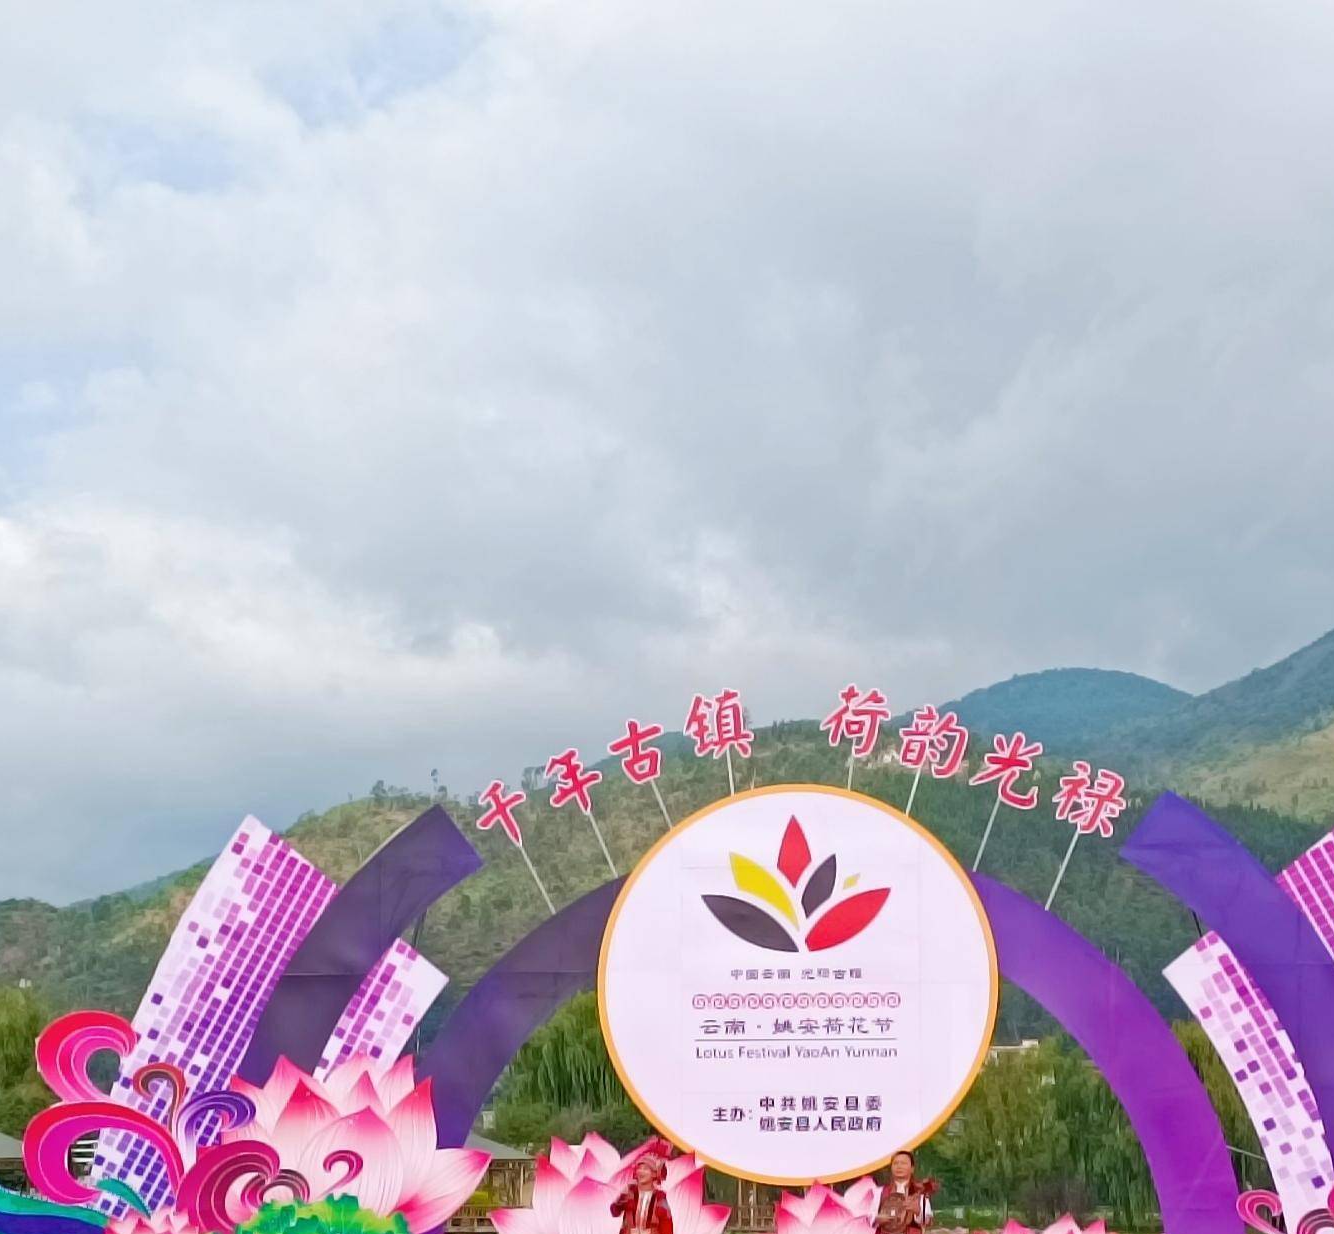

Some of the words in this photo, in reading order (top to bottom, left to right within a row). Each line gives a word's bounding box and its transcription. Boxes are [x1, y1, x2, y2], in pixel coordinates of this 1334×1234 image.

[820, 683, 1126, 837] 荷韵光禄
[696, 1046, 734, 1059] Lotus
[738, 1046, 791, 1059] Festival
[795, 1046, 840, 1058] YaoAn
[844, 1046, 898, 1058] Yunnan
[759, 1096, 882, 1111] 中共姚安县委
[759, 1116, 882, 1131] 姚安县人民政府
